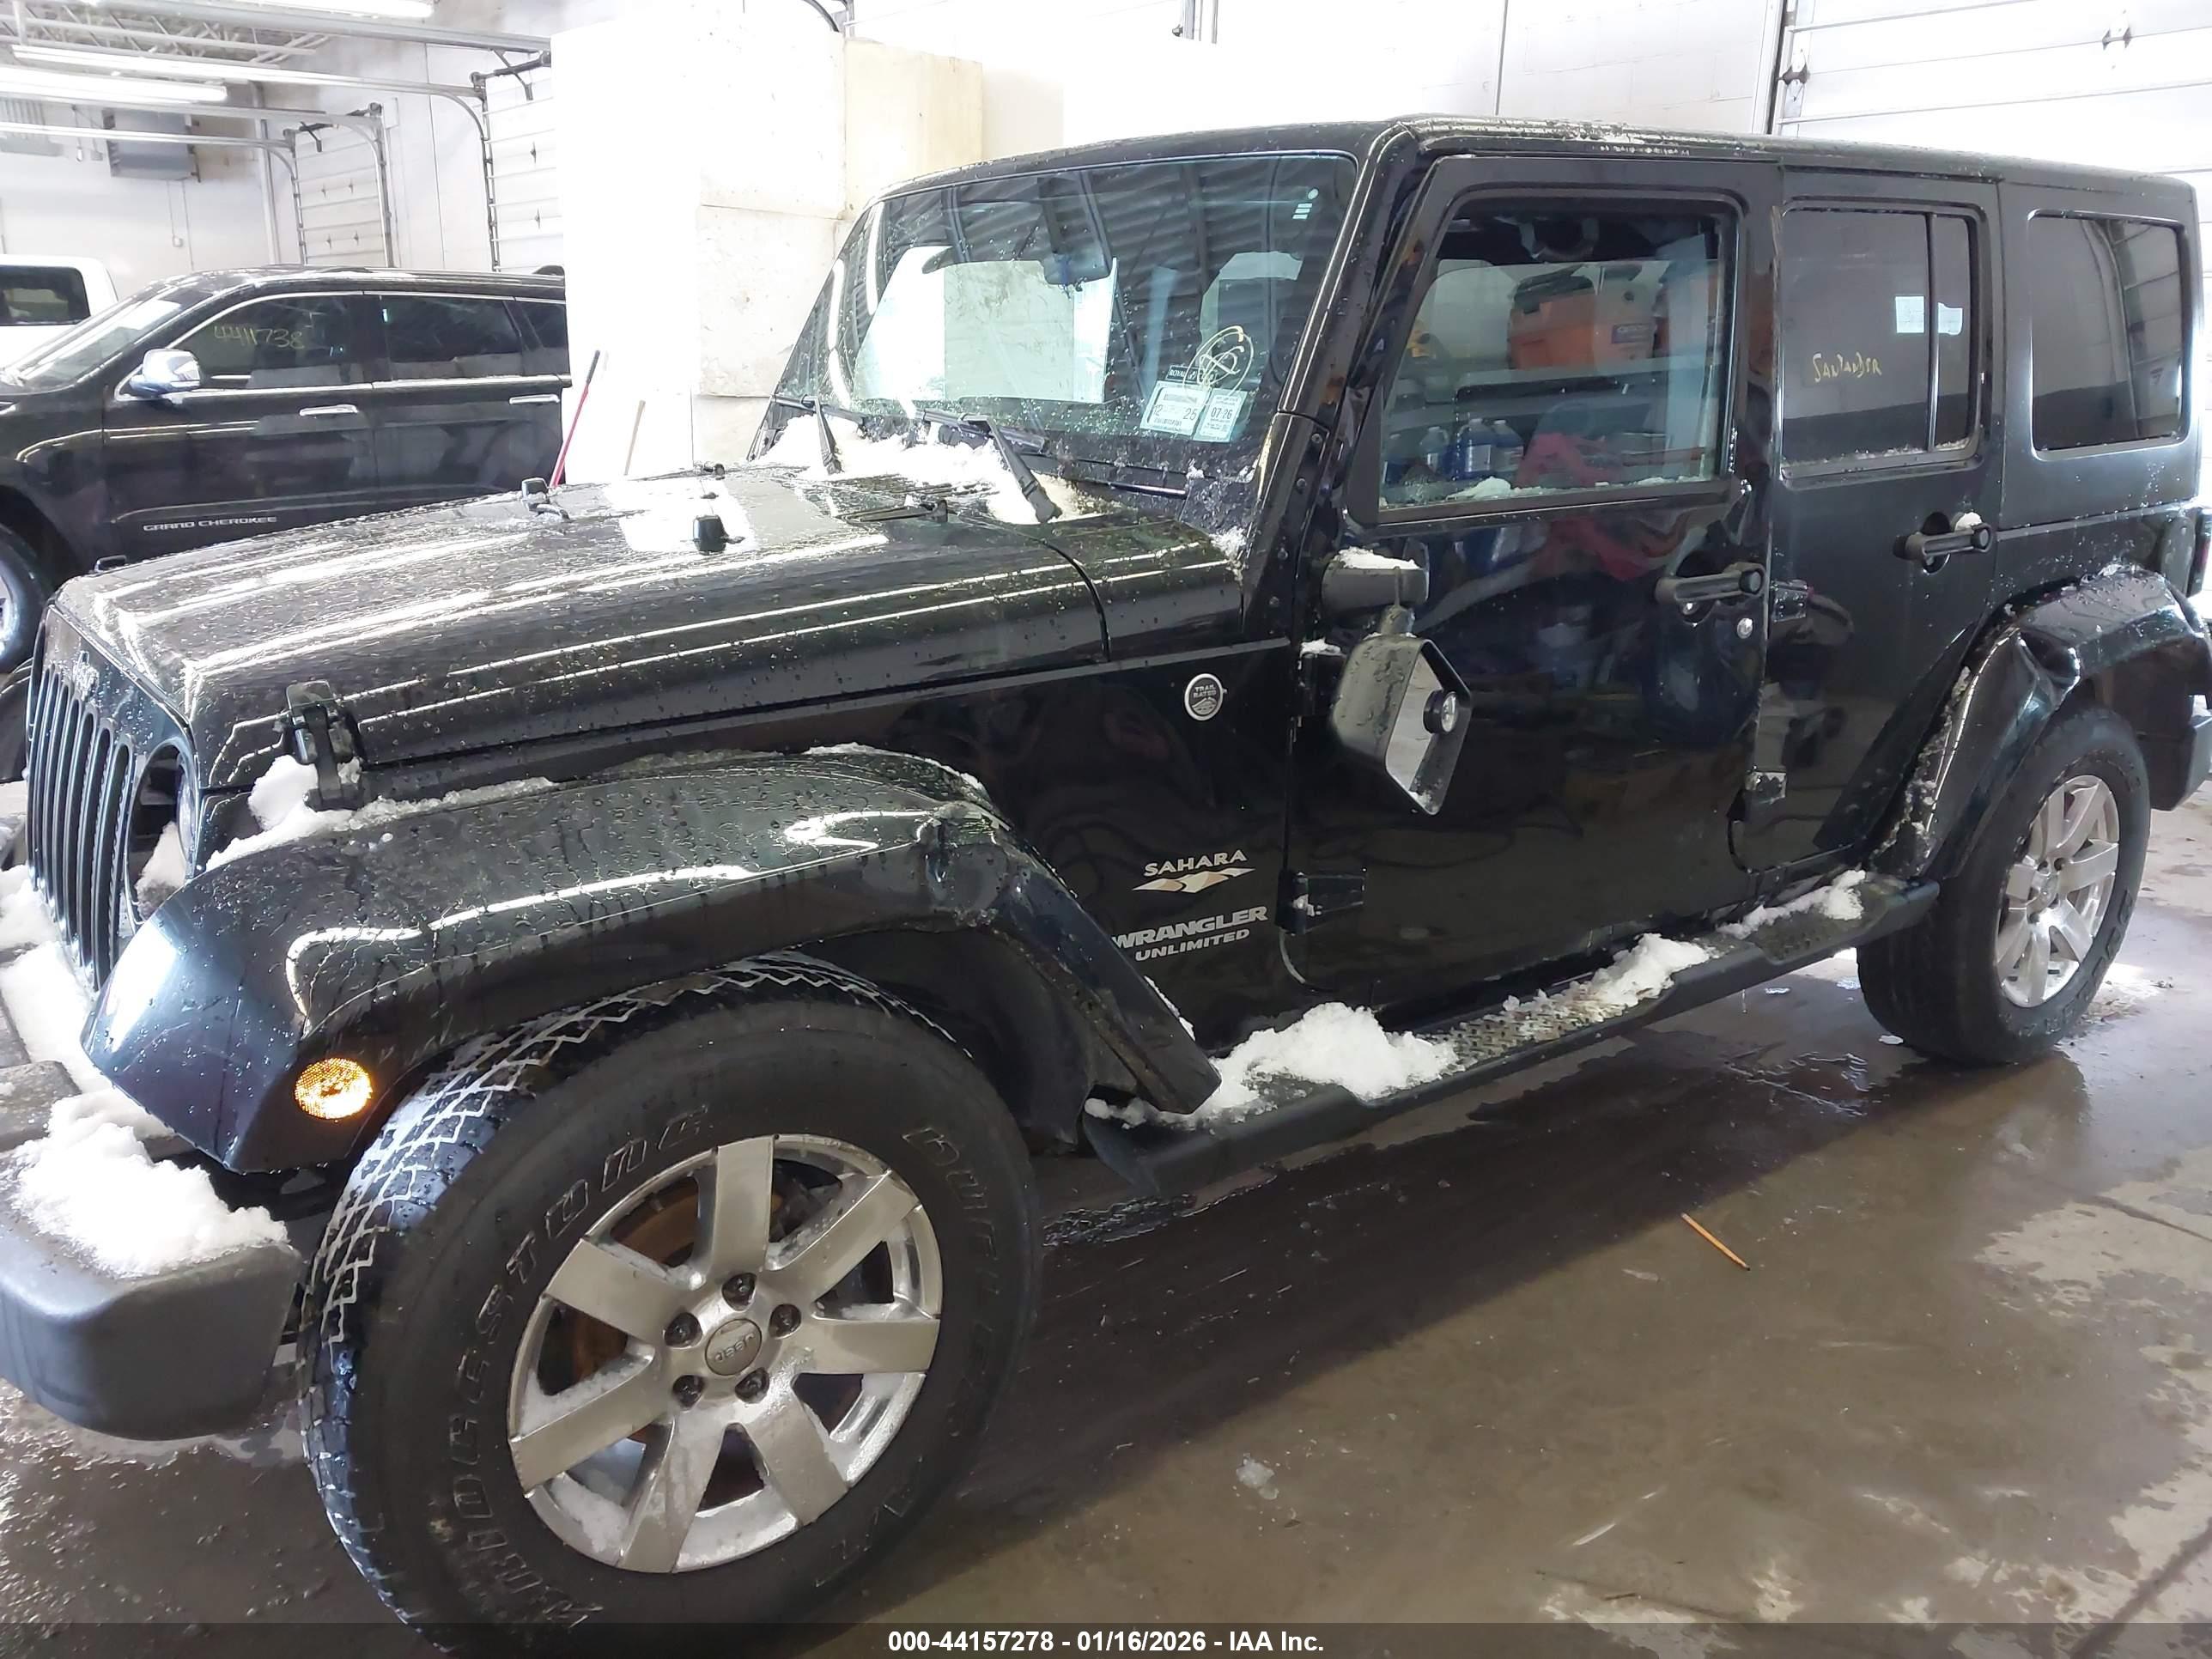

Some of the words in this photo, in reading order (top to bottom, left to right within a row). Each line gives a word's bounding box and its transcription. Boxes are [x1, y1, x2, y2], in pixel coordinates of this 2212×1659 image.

[1182, 407, 1199, 422] 25
[143, 522, 196, 532] GRAND
[198, 516, 278, 528] CHEROKEE
[1193, 690, 1217, 699] RATED
[1194, 684, 1217, 693] TRAIL
[1143, 849, 1248, 877] SAHARA
[1112, 906, 1269, 949] WRANGLER
[1135, 928, 1251, 962] UNLIMITED
